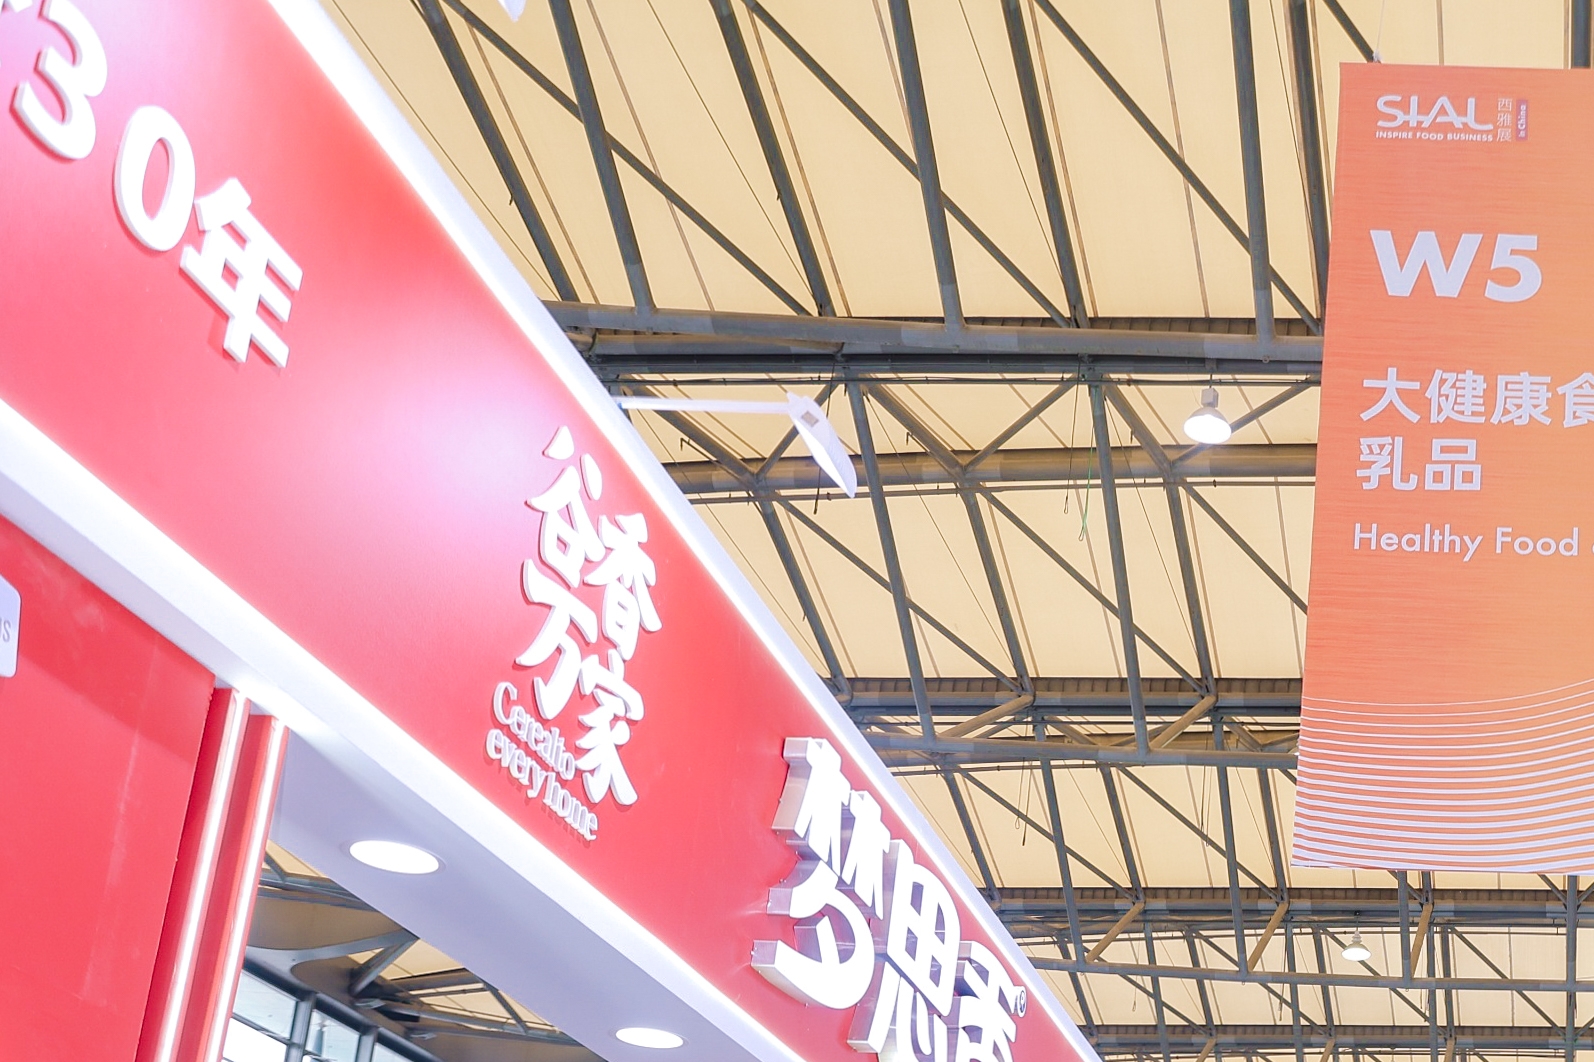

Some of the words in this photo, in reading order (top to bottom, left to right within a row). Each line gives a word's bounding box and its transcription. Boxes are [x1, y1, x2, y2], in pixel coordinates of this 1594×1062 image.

[1376, 94, 1494, 131] SIAL
[1496, 97, 1513, 143] 西雅展
[1517, 104, 1527, 130] China
[1375, 130, 1413, 139] INSPIRE
[1416, 131, 1444, 141] FOOD
[1447, 133, 1494, 143] BUSINESS
[1370, 230, 1542, 302] W5
[1356, 435, 1482, 491] 乳品
[1353, 522, 1482, 562] Healthy
[1495, 527, 1579, 557] Food
